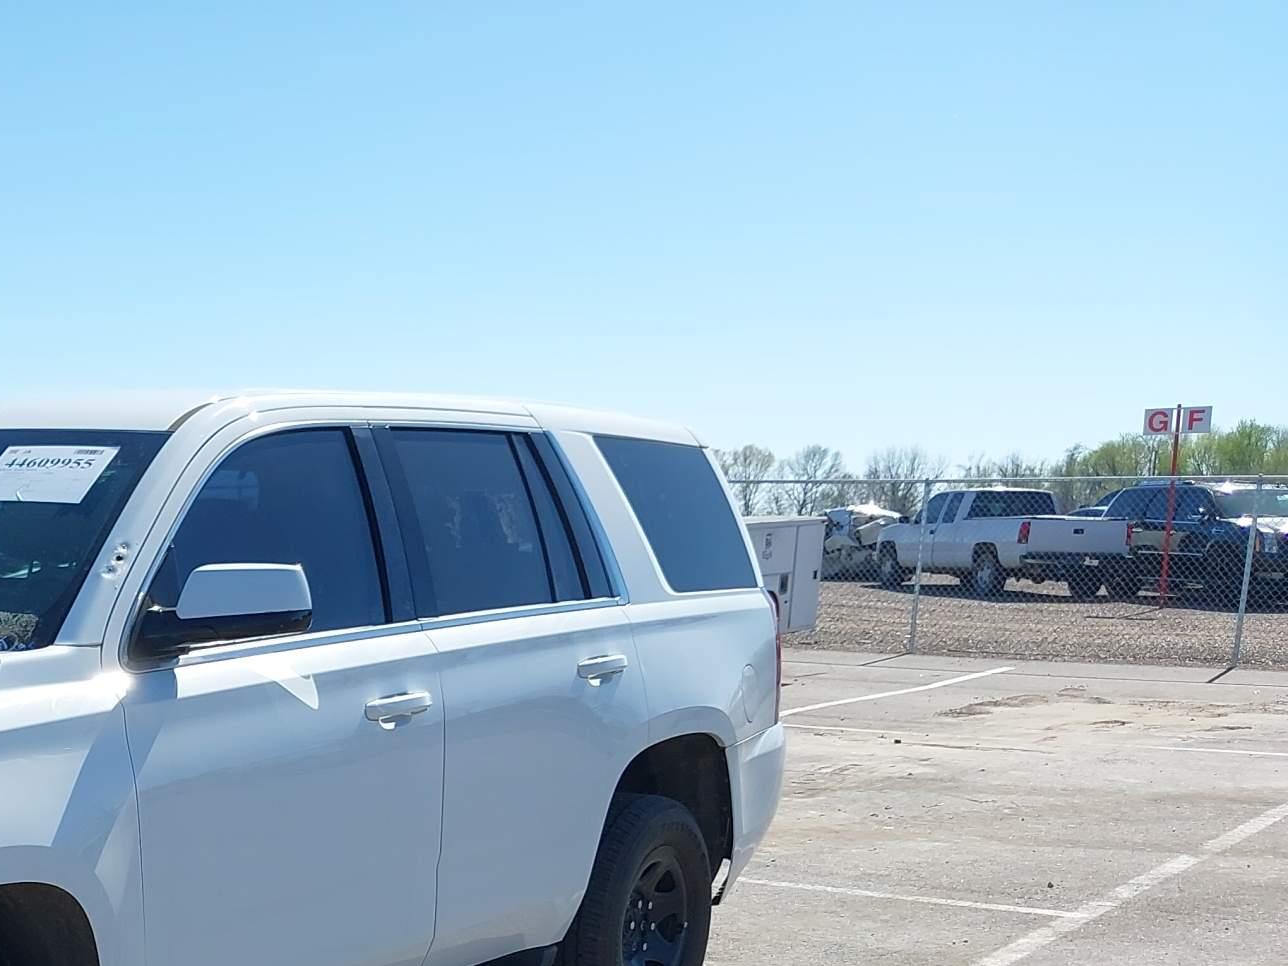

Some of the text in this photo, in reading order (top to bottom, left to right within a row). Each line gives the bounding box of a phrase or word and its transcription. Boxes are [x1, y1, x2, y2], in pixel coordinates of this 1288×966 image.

[1148, 411, 1169, 432] G
[1188, 409, 1206, 431] F
[4, 457, 96, 470] 44609955
